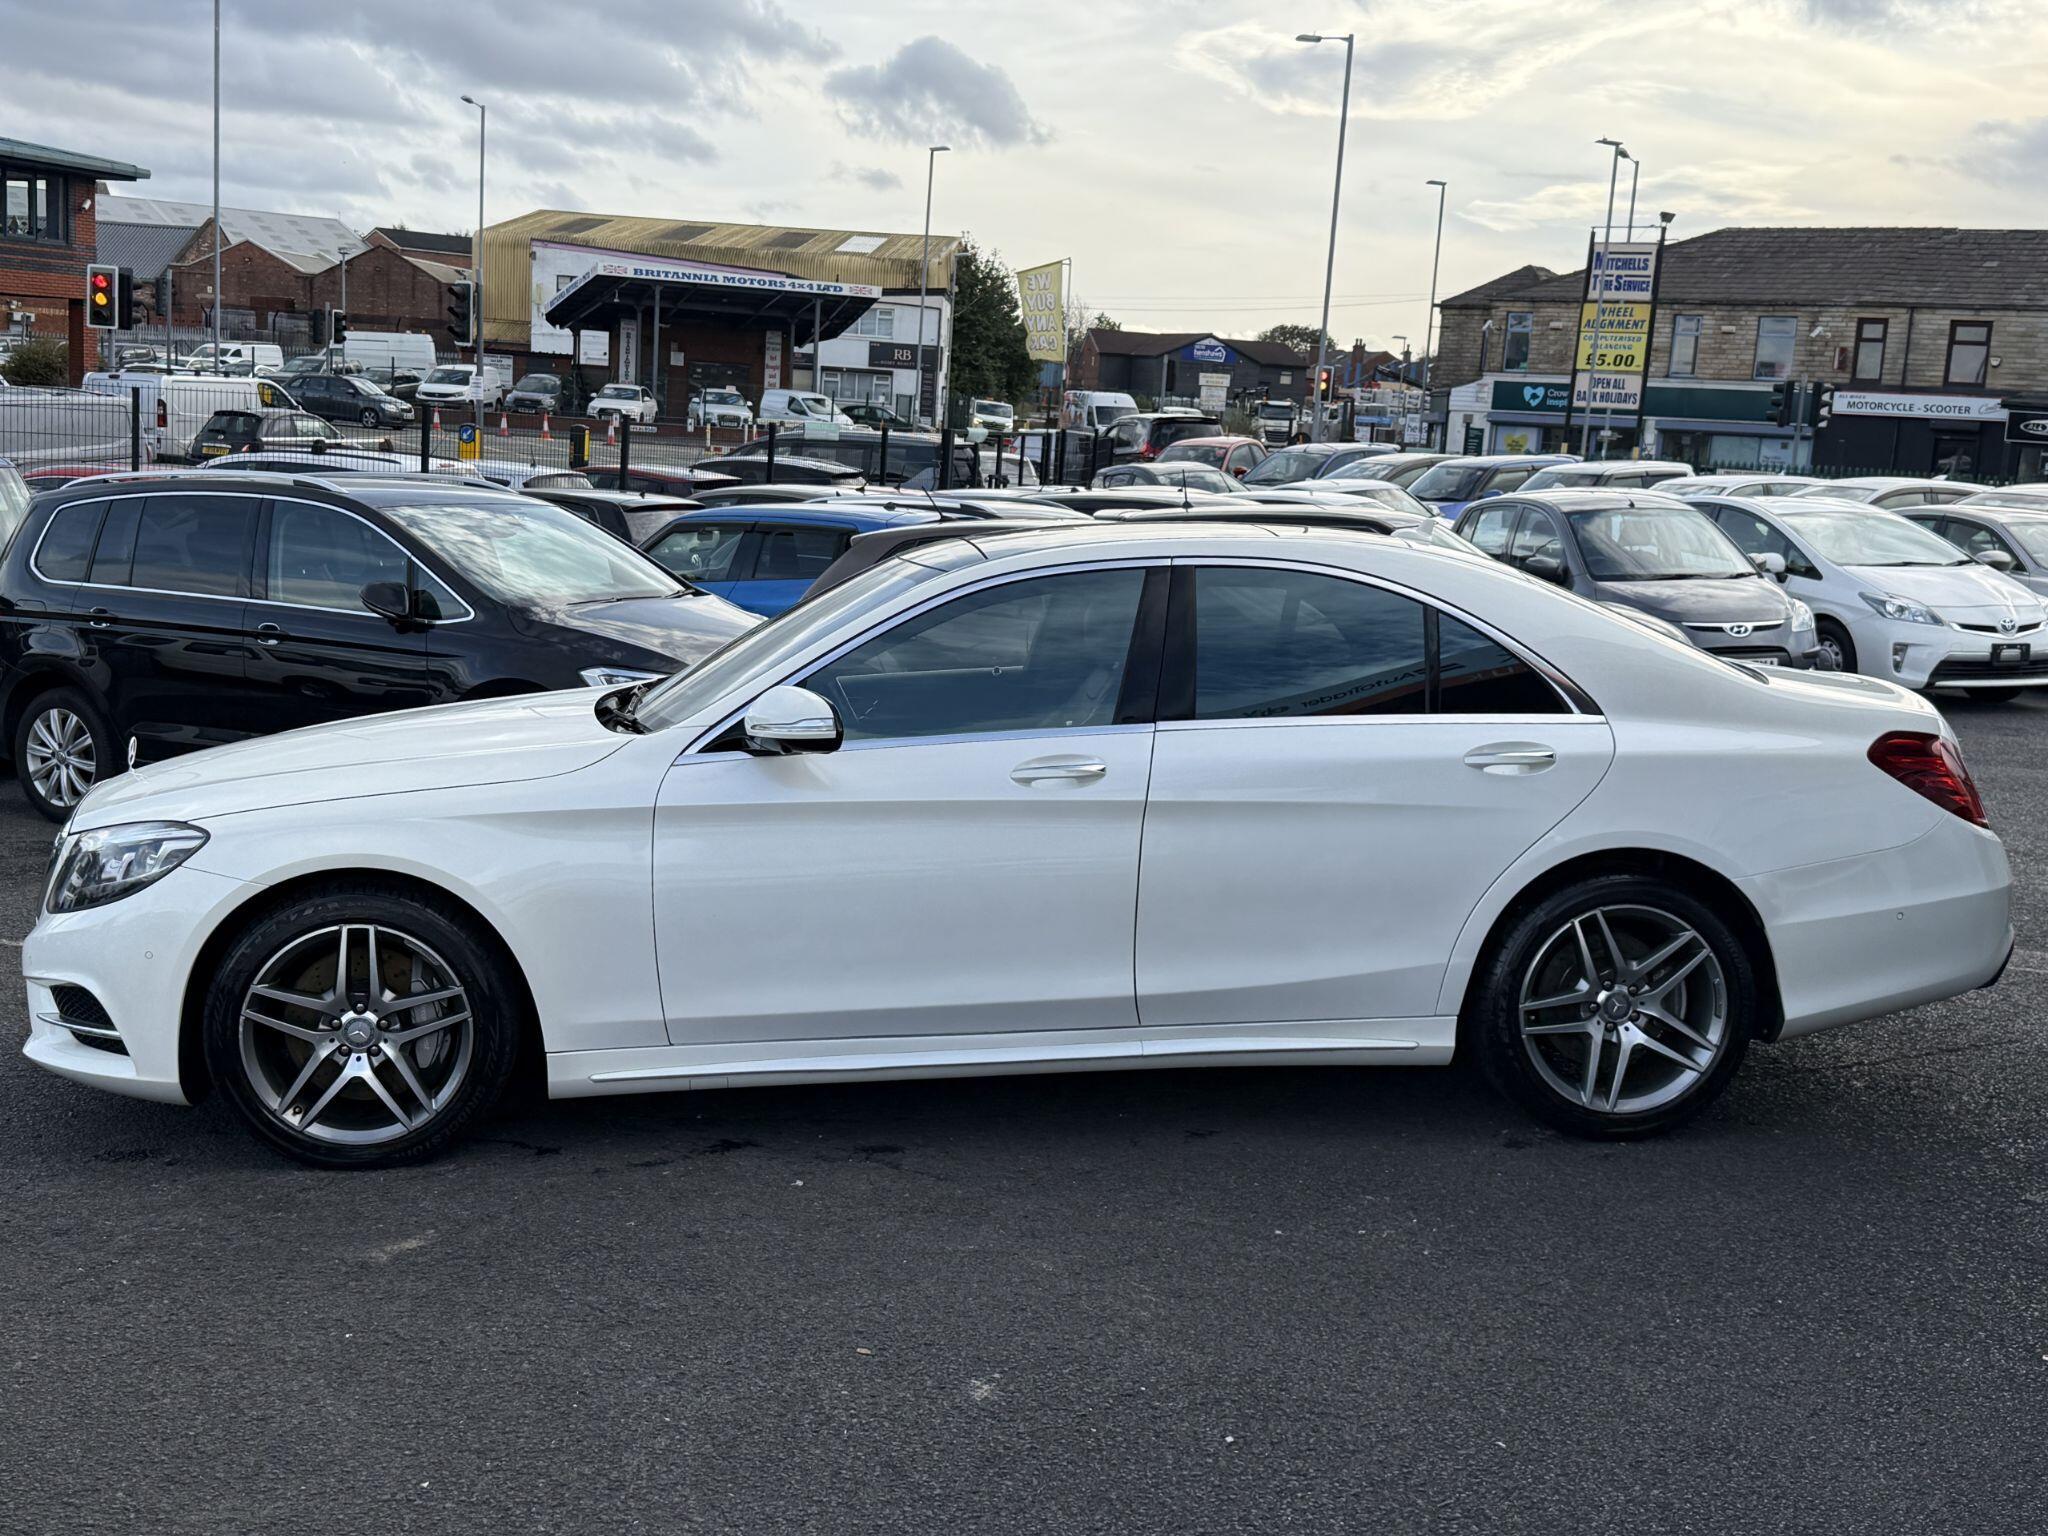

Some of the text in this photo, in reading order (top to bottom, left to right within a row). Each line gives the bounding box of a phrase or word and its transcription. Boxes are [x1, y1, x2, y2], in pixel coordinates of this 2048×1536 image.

[1594, 252, 1650, 271] MITCHELLS
[633, 267, 719, 283] BRITANNIA
[722, 275, 786, 288] MOTORS
[816, 283, 843, 292] LTD
[1592, 274, 1650, 292] TRE SERVICE
[1599, 307, 1635, 317] WHEEL
[1583, 319, 1646, 330] ALGNMENT
[1583, 334, 1642, 343] COPUTERISED
[894, 349, 911, 360] RB
[1585, 353, 1635, 367] £5.00
[1612, 378, 1626, 390] ALL
[1576, 390, 1638, 405] BAK HOLIDAYS
[1846, 401, 1915, 412] MOTORCYCLE
[1923, 404, 1971, 415] SCOOTER
